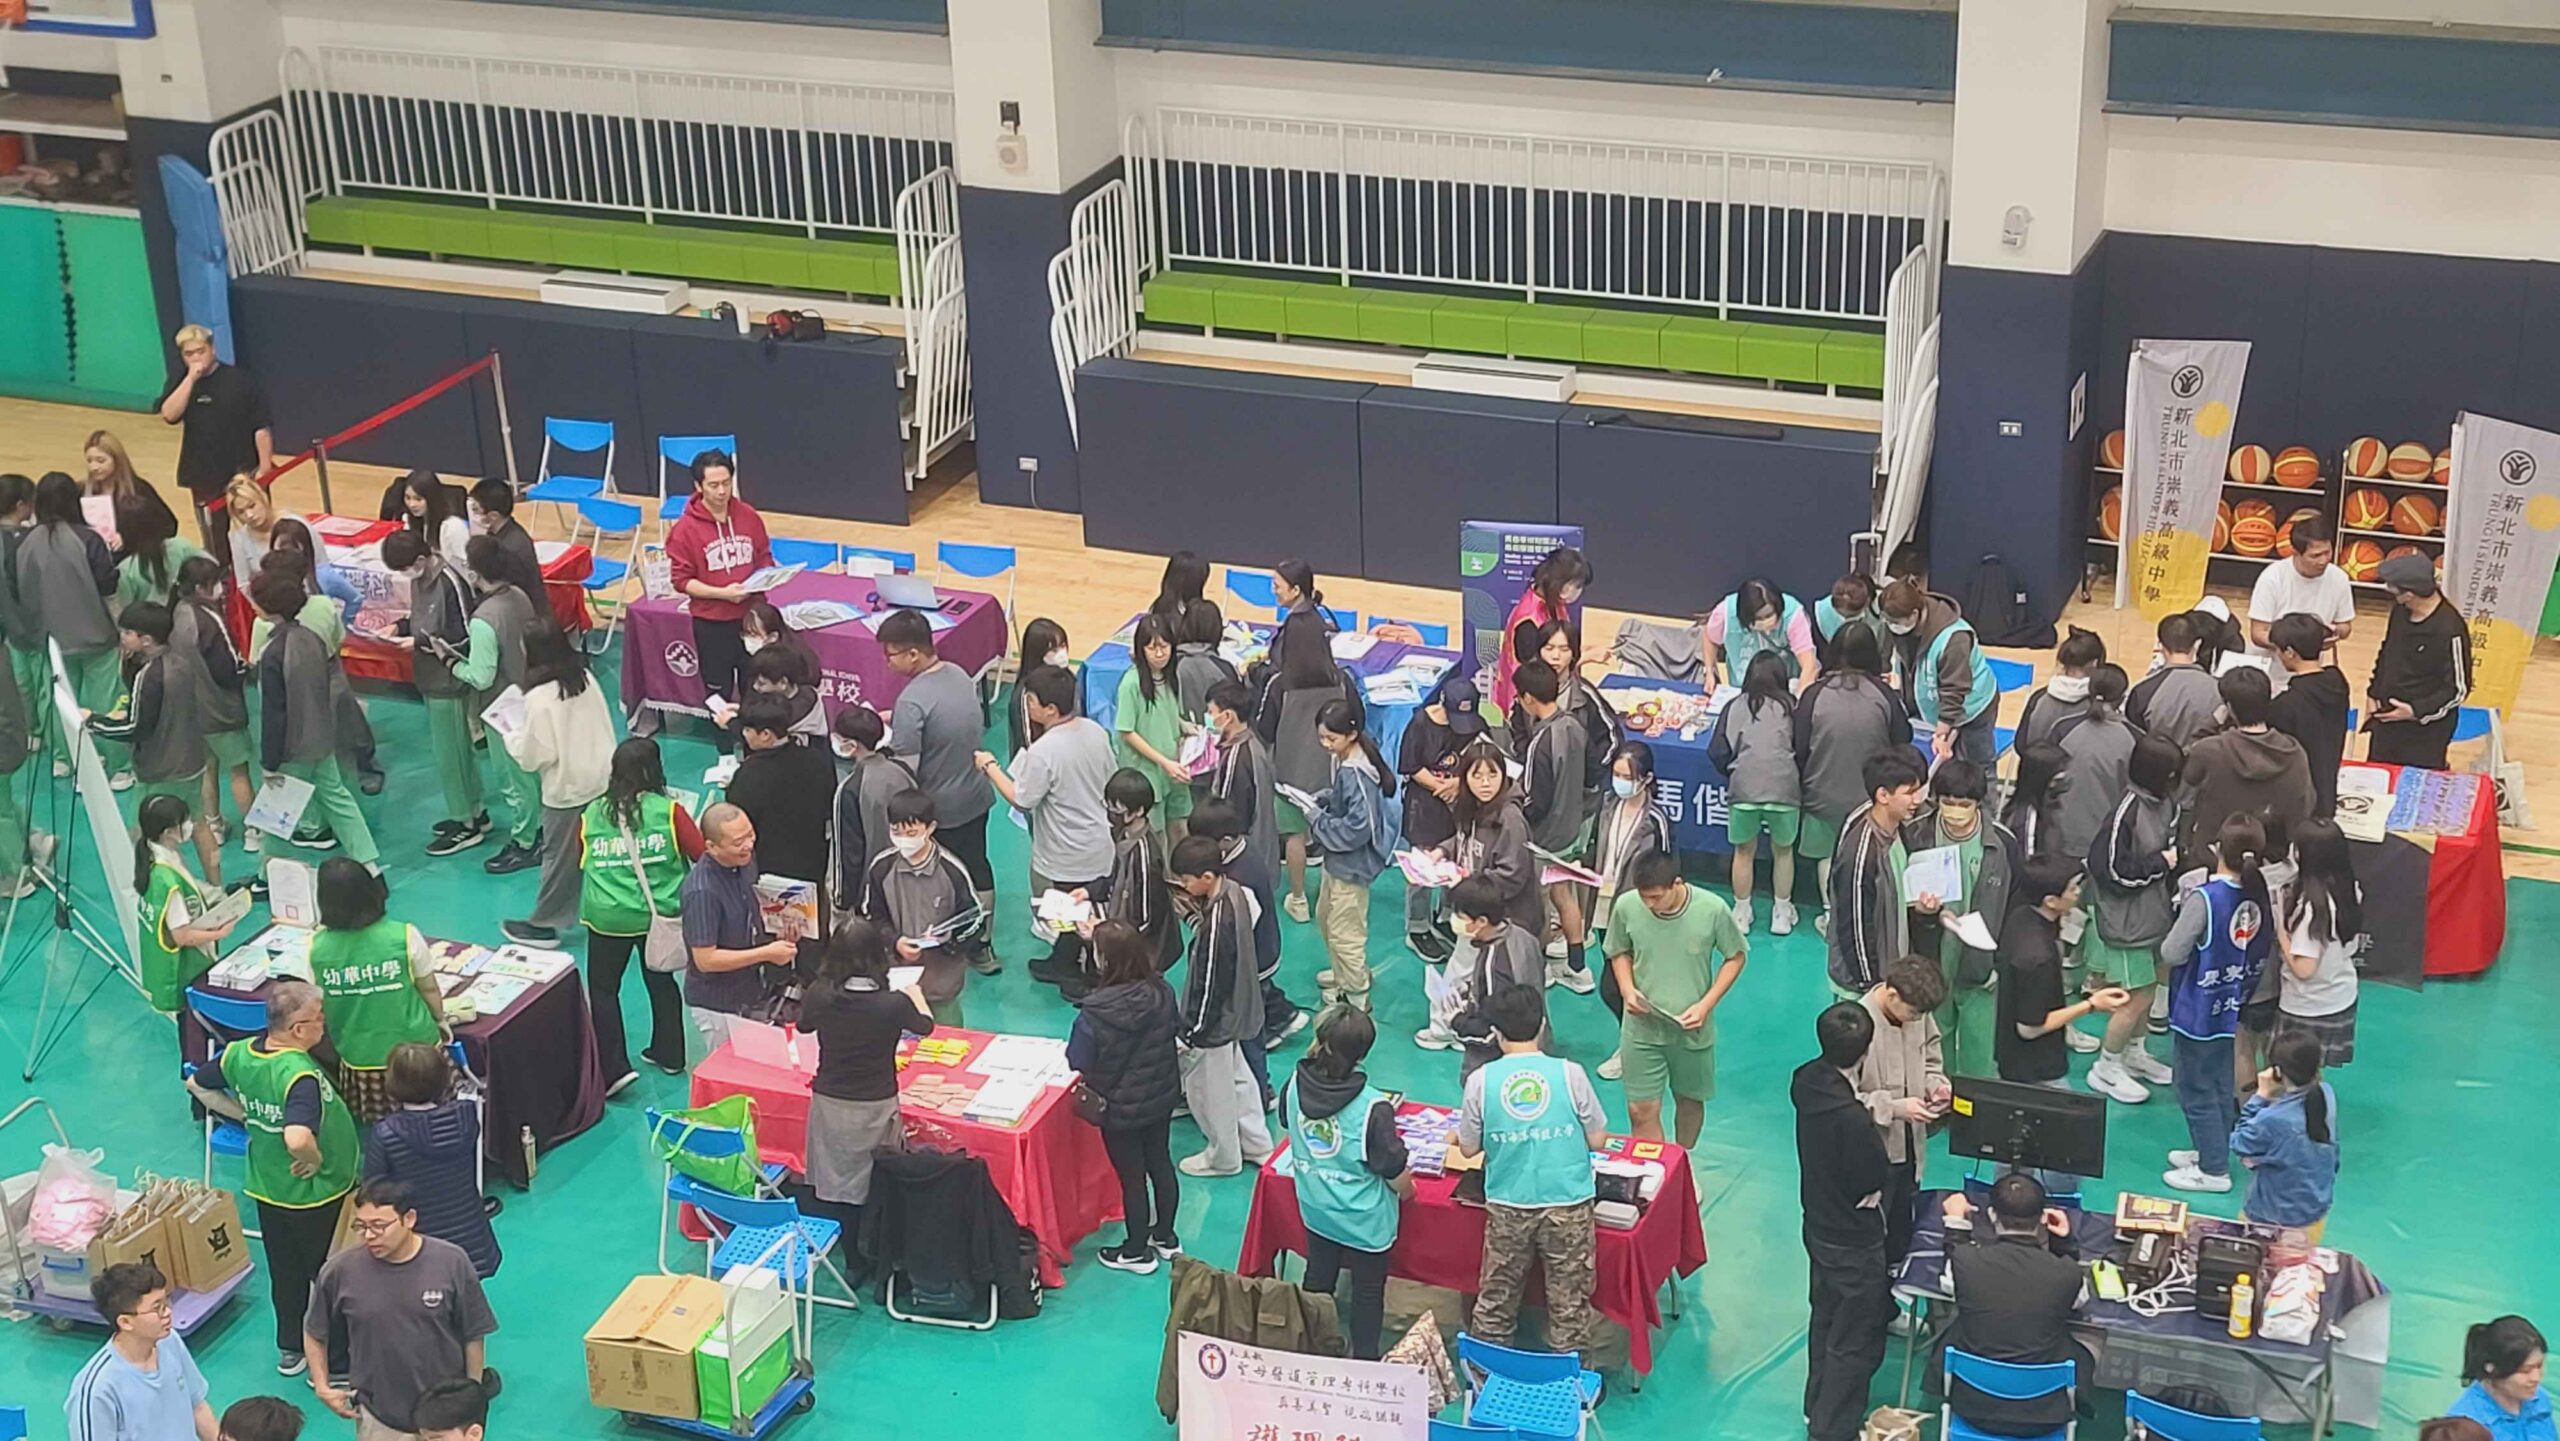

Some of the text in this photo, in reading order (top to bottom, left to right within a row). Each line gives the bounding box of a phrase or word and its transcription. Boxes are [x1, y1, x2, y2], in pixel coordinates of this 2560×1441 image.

[2143, 406, 2194, 602] 新北市崇義高級中學
[2470, 494, 2525, 692] 新北市崇義高級中
[1653, 778, 1729, 826] 馬偕
[322, 959, 402, 986] 幼華中學
